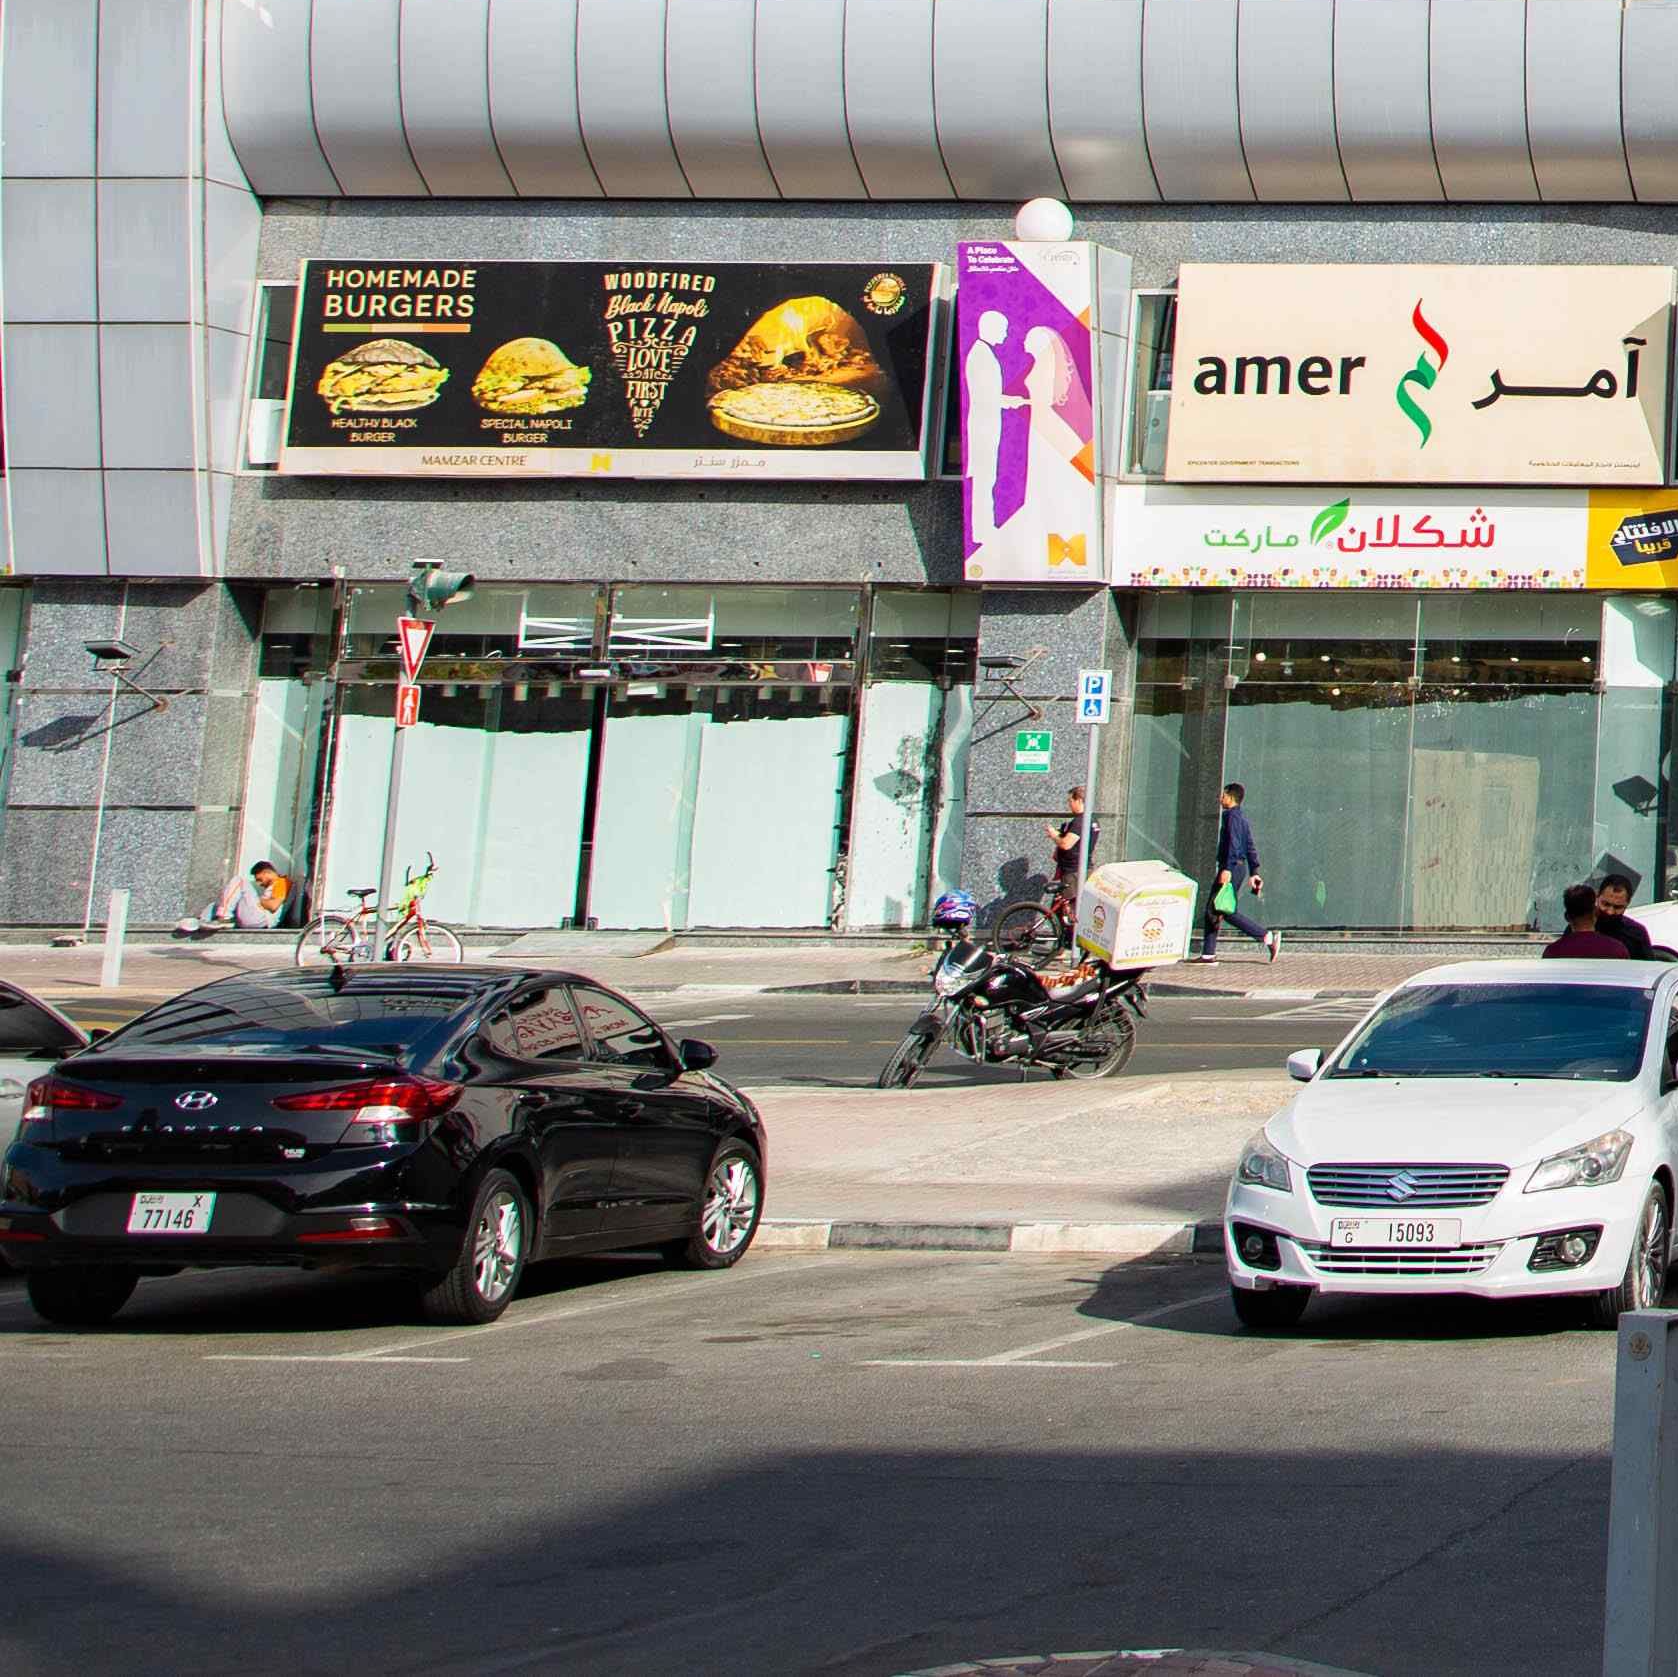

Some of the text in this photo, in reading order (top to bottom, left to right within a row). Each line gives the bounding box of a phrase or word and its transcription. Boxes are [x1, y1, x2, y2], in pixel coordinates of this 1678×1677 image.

[327, 269, 477, 288] HOMEMADE
[604, 272, 716, 293] WOODFIRED
[324, 294, 475, 317] BURGERS
[605, 292, 710, 320] Black Napoli
[607, 317, 697, 347] PIZZA
[627, 348, 673, 372] LOVE
[1194, 354, 1366, 397] amer
[1472, 337, 1648, 409] آمر
[626, 381, 668, 399] FIRST
[331, 418, 417, 429] HEALTHY BLACK
[480, 418, 573, 430] SPECIAL NAPOLI
[349, 432, 396, 443] BURGER
[502, 432, 548, 443] BURGER
[421, 454, 528, 466] MAMZAR CENTRE
[1203, 507, 1496, 553] شكلان ماركت
[121, 1125, 264, 1133] ELANTRA
[192, 1195, 203, 1207] X
[143, 1209, 195, 1229] 77146
[1345, 1223, 1435, 1243] G 15093
